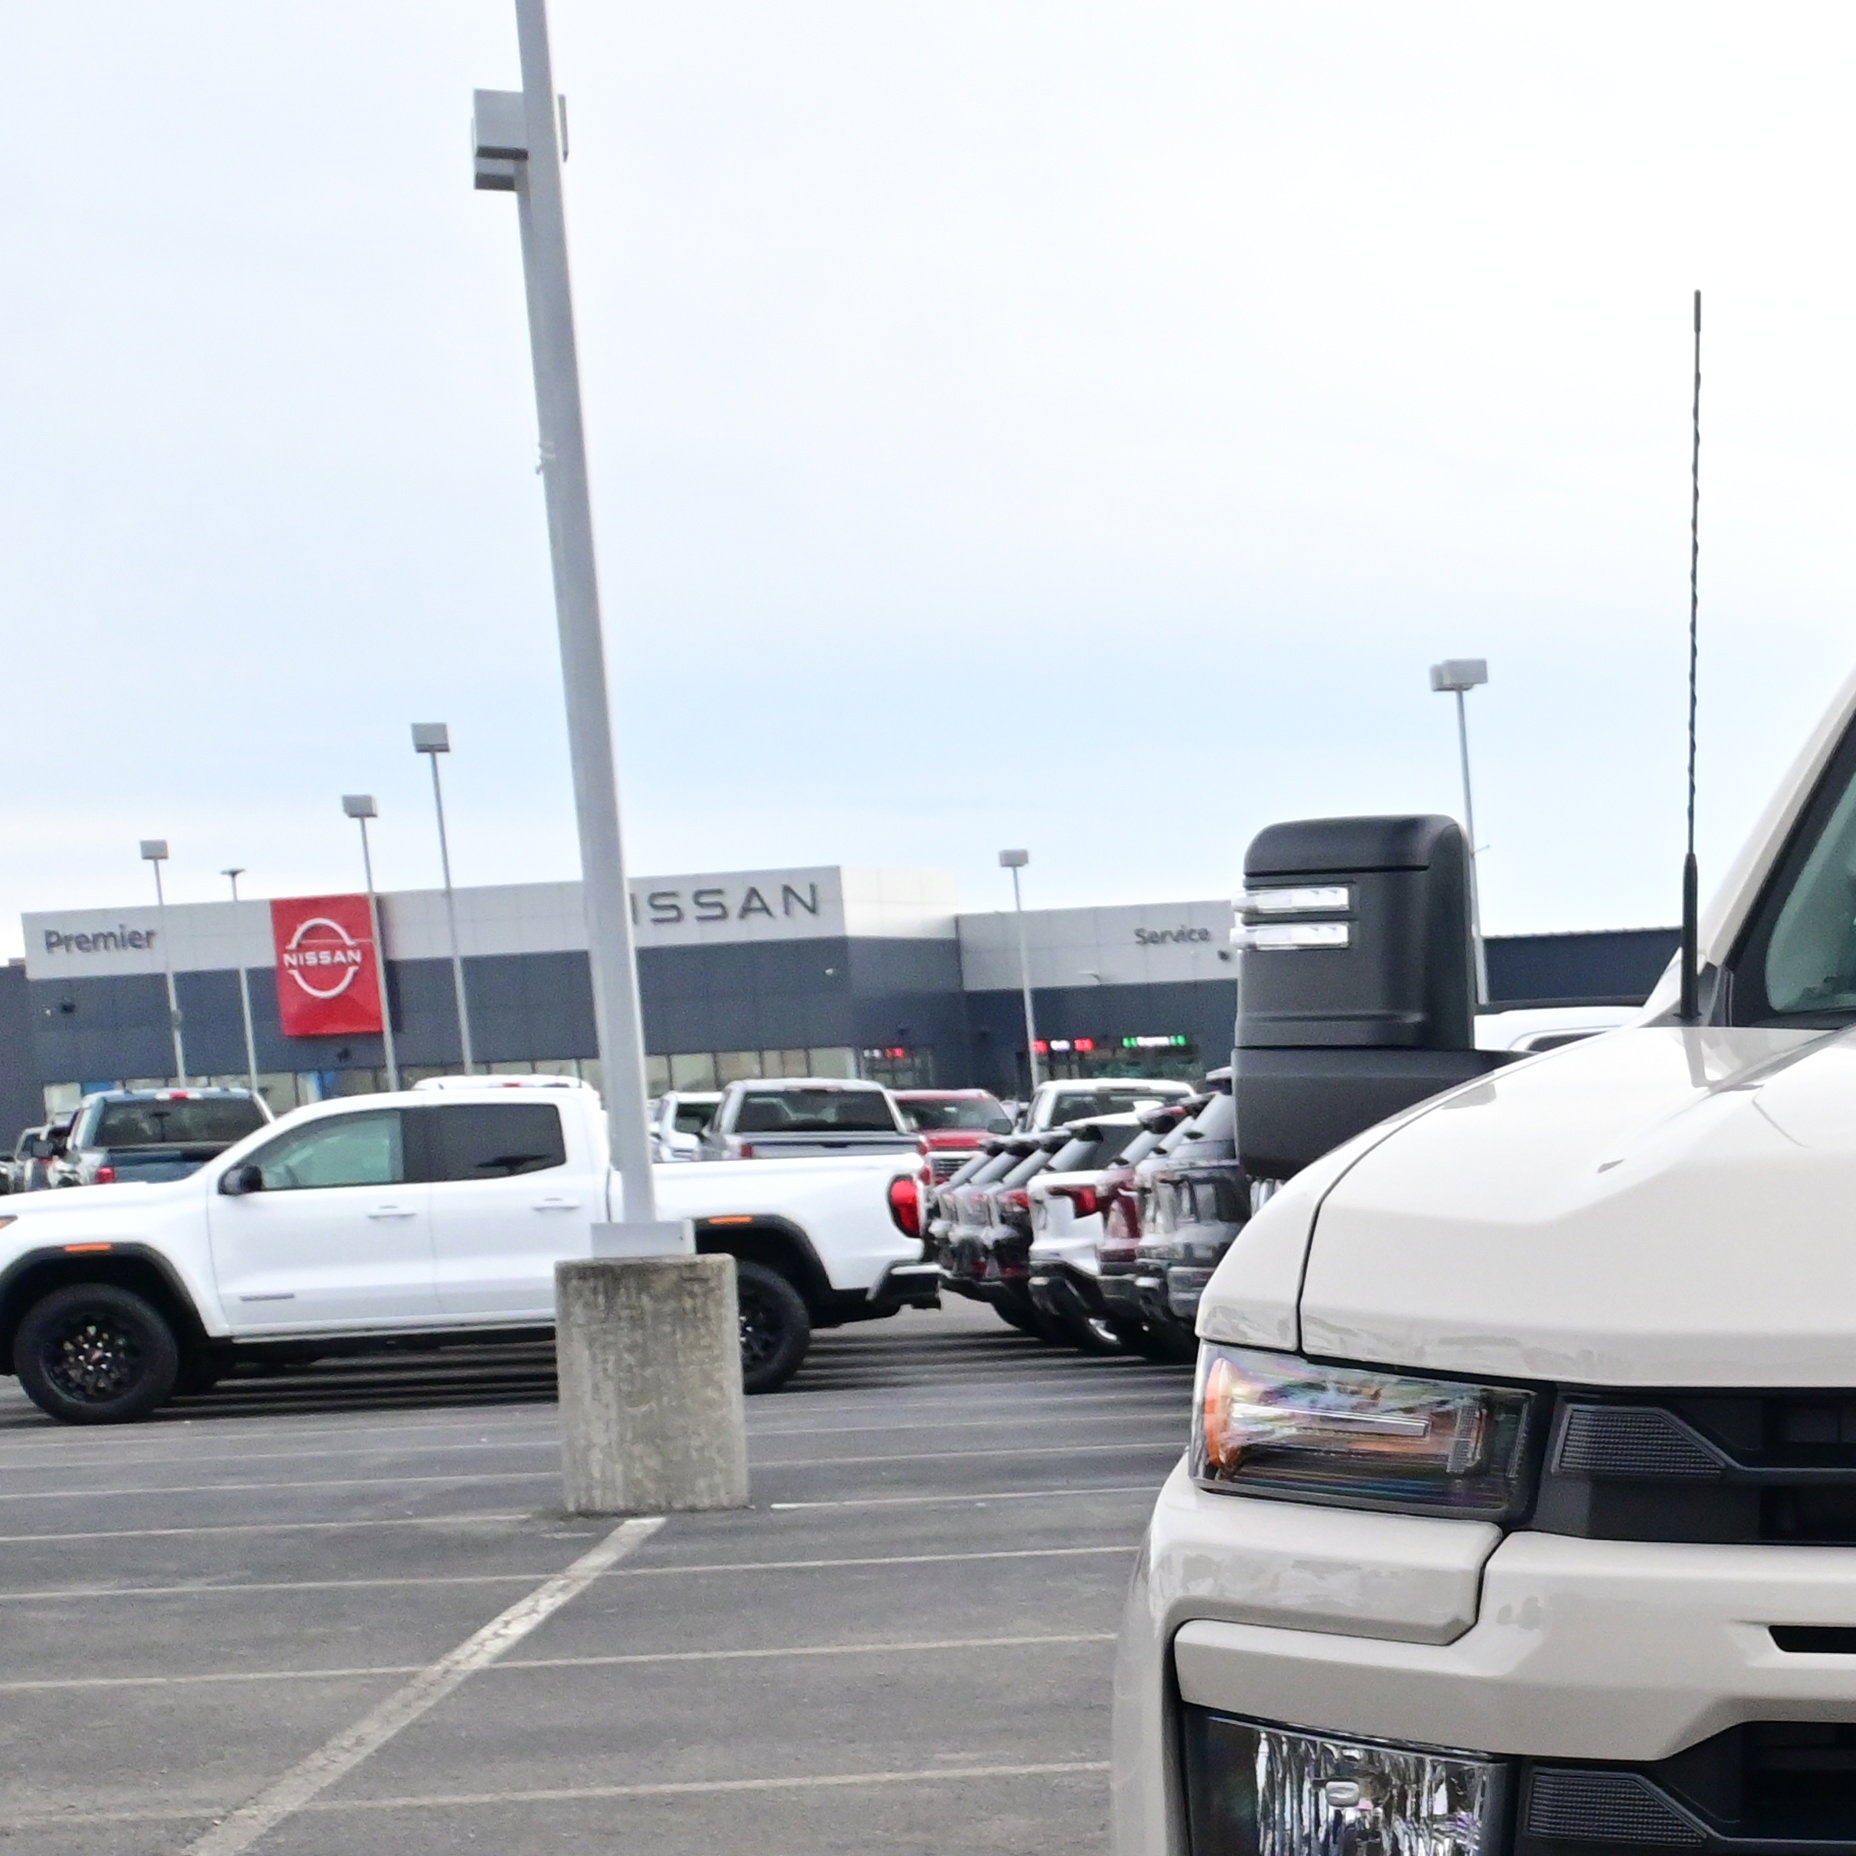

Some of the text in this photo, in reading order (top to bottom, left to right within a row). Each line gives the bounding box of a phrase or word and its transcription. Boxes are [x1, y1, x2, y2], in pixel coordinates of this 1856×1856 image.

[630, 881, 819, 926] ISSAN
[43, 923, 159, 955] Premier
[1134, 925, 1211, 946] Service
[283, 949, 362, 968] NISSAN
